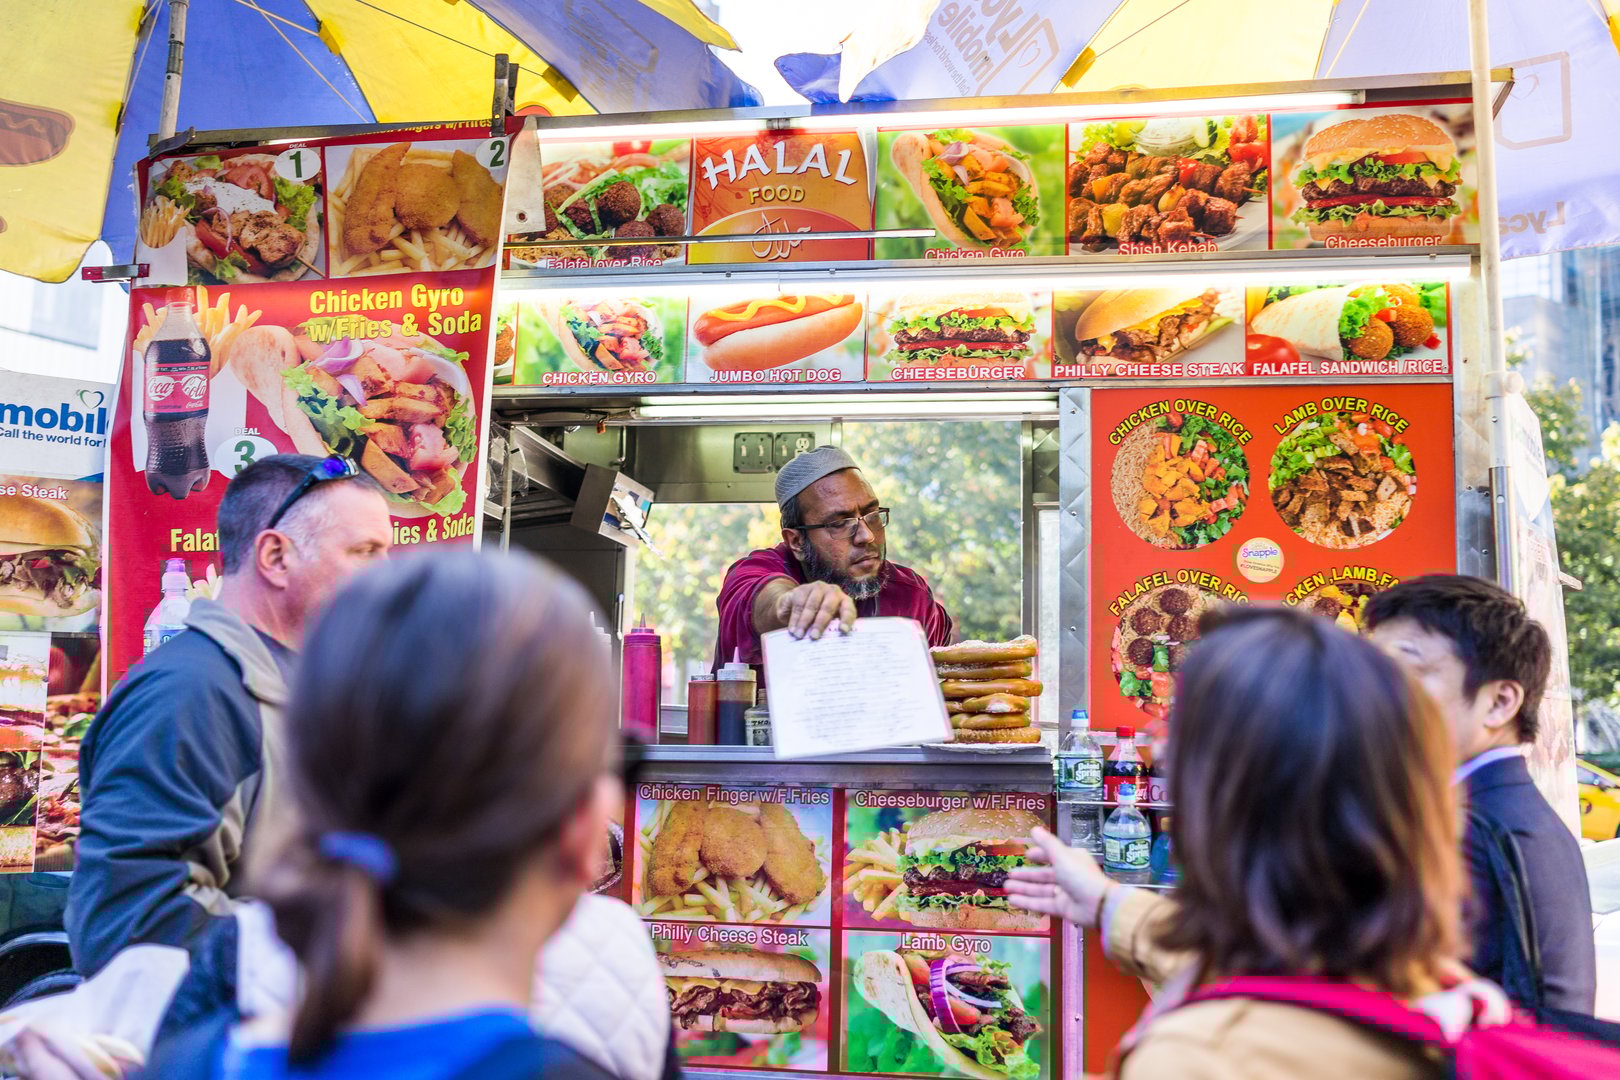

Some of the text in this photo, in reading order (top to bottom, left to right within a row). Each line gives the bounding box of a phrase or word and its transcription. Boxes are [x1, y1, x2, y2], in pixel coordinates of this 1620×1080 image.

[489, 140, 505, 167] 2
[289, 151, 302, 178] 1
[701, 141, 858, 190] HALAL
[748, 184, 806, 204] FOOD
[1118, 239, 1219, 256] Shish Kebab
[1325, 234, 1442, 248] Cheeseburger
[546, 256, 663, 270] Falafel over Rice
[924, 248, 984, 260] Chicken
[310, 284, 464, 314] Chicken Gyro
[310, 310, 483, 344] w/Fries & Soda
[542, 371, 657, 384] CHICKEN GYRO
[709, 369, 842, 382] JUMBO HOT DOG
[892, 367, 1026, 380] CHEESEBURGER
[1054, 364, 1245, 377] PHILLY CHEESE STEAK
[1253, 362, 1317, 375] FALAFEL
[1320, 361, 1399, 374] SANDWICH
[0, 403, 110, 435] mobil
[1108, 399, 1253, 445] CHICKEN OVER RICE
[1273, 396, 1410, 435] LAMB OVER RICE
[22, 430, 44, 441] the
[46, 434, 82, 446] world
[84, 437, 103, 448] for
[234, 440, 256, 476] 3
[22, 484, 68, 499] Steak
[170, 513, 474, 552] Falaf ies & Soda
[1242, 546, 1278, 558] Snapple
[1109, 569, 1250, 616] FALAFEL OVER RIC
[1284, 572, 1326, 606] CKEN
[640, 785, 830, 805] Chicken Finger w/F.Fries
[855, 791, 1046, 811] Cheeseburger w/F.Fries
[651, 925, 809, 946] Philly Cheese Steak
[901, 933, 991, 953] Lamb Gyro
